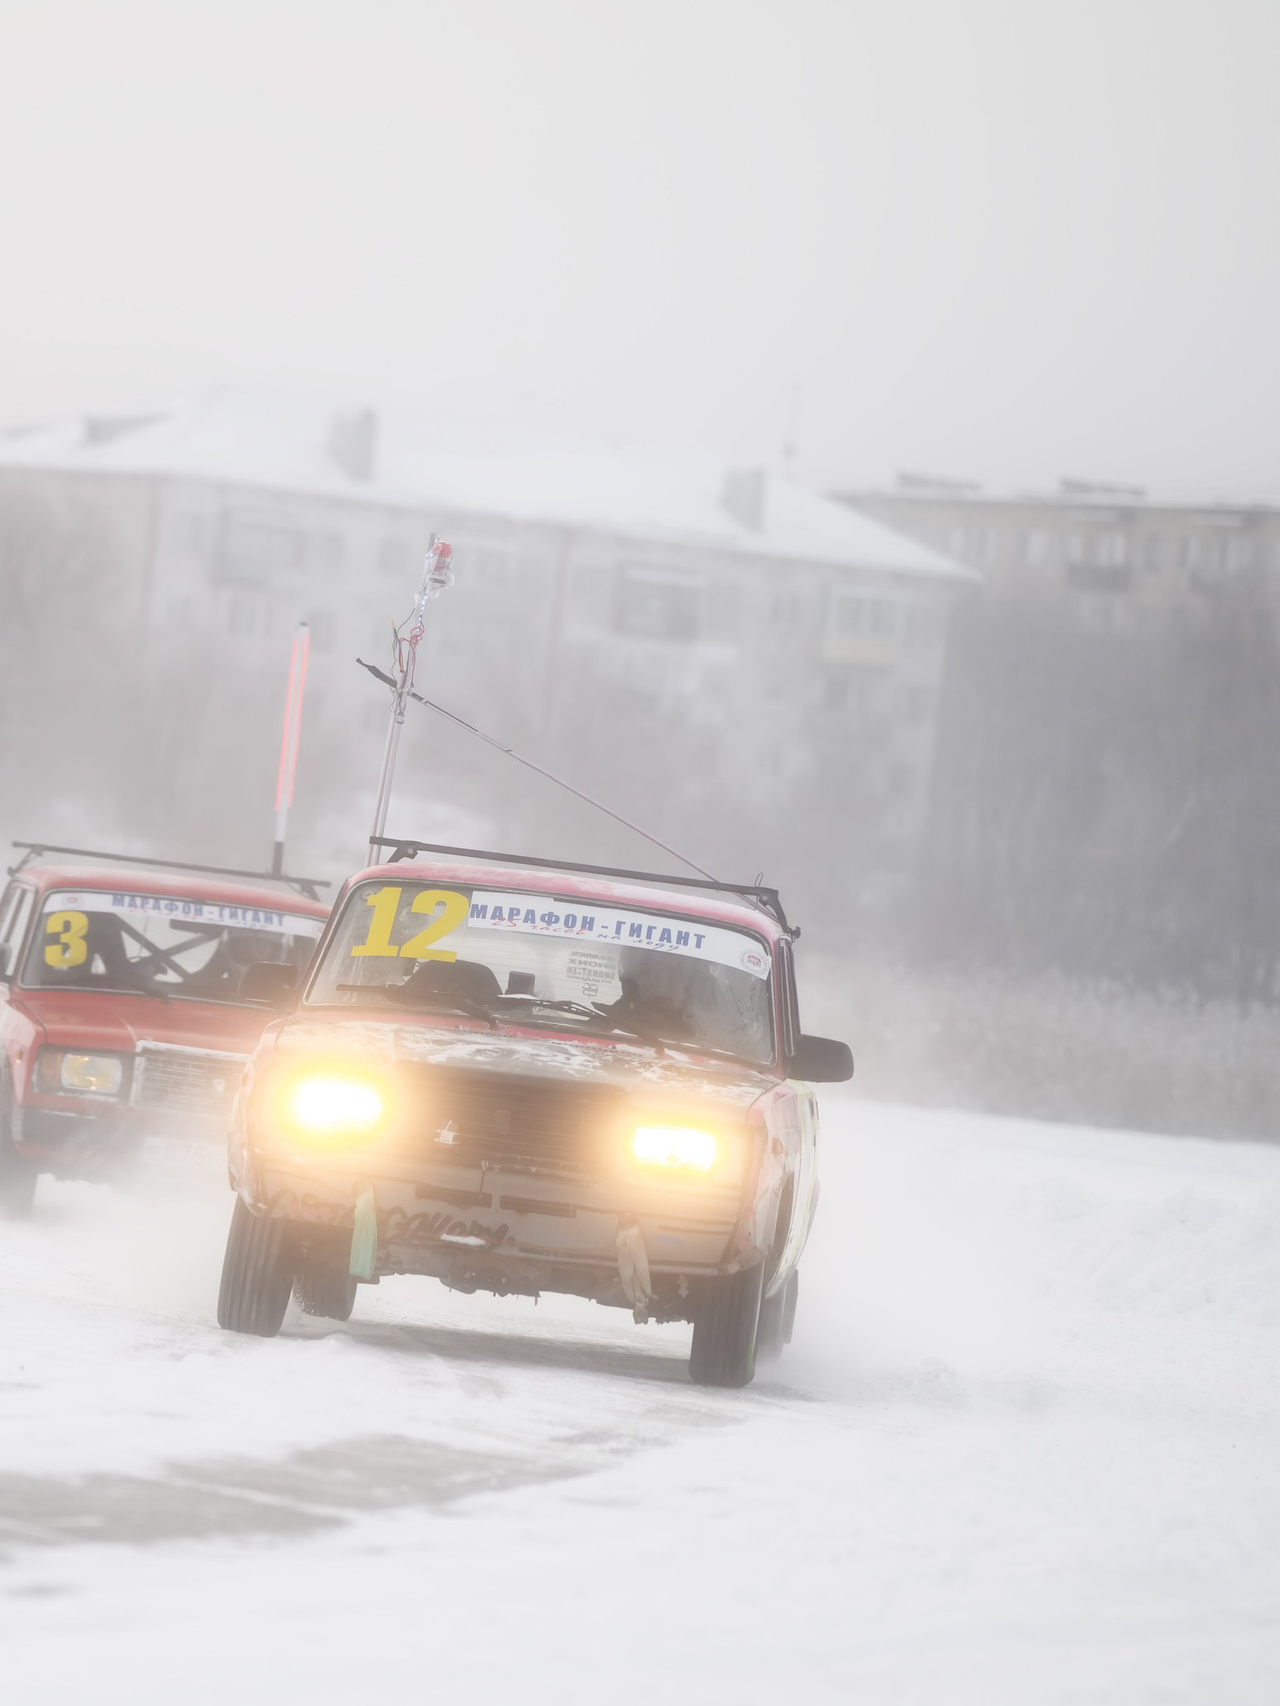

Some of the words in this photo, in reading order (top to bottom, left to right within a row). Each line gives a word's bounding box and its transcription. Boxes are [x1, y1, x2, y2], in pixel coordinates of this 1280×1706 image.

[44, 911, 89, 967] 3
[350, 887, 469, 963] 12
[491, 916, 521, 928] 25
